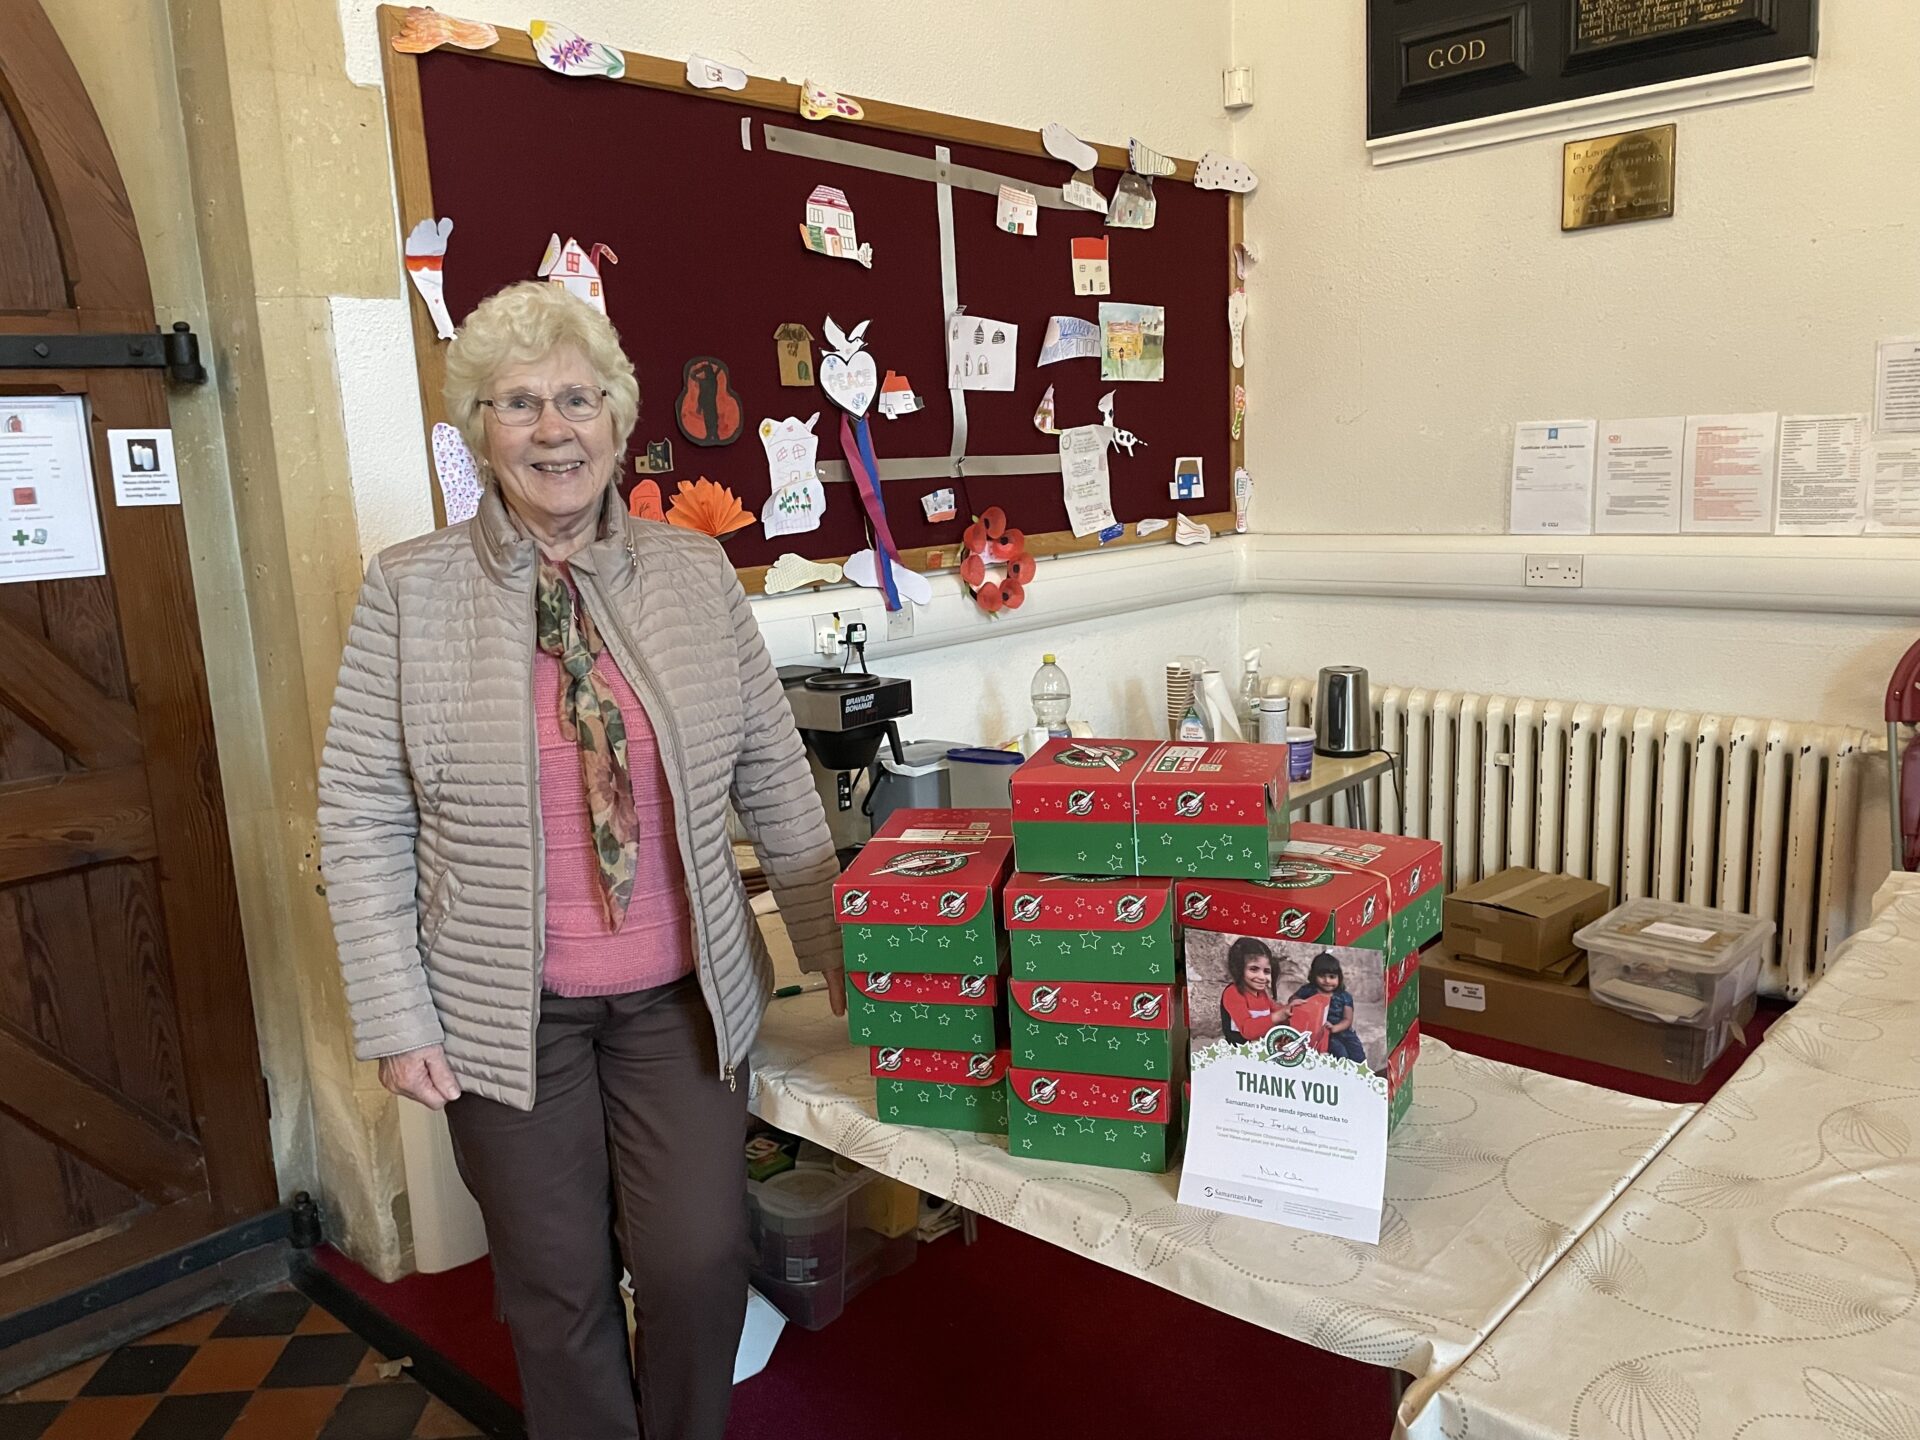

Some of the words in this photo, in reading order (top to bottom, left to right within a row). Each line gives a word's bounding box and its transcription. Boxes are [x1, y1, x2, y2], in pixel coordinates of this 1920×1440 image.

[1428, 39, 1486, 70] GOD
[1573, 152, 1582, 160] In
[828, 369, 874, 391] PEACE
[845, 693, 875, 706] BRAVILOR
[845, 701, 874, 714] BONAMAT
[1235, 1070, 1297, 1100] THANK
[1301, 1080, 1339, 1106] YOU
[1225, 1098, 1259, 1109] Samaritan's
[1260, 1103, 1277, 1112] Purse
[1278, 1107, 1296, 1115] sends
[1297, 1110, 1319, 1119] special
[1319, 1113, 1341, 1123] thanks
[1214, 1188, 1247, 1201] Samaritan's
[1247, 1195, 1264, 1205] Purse
